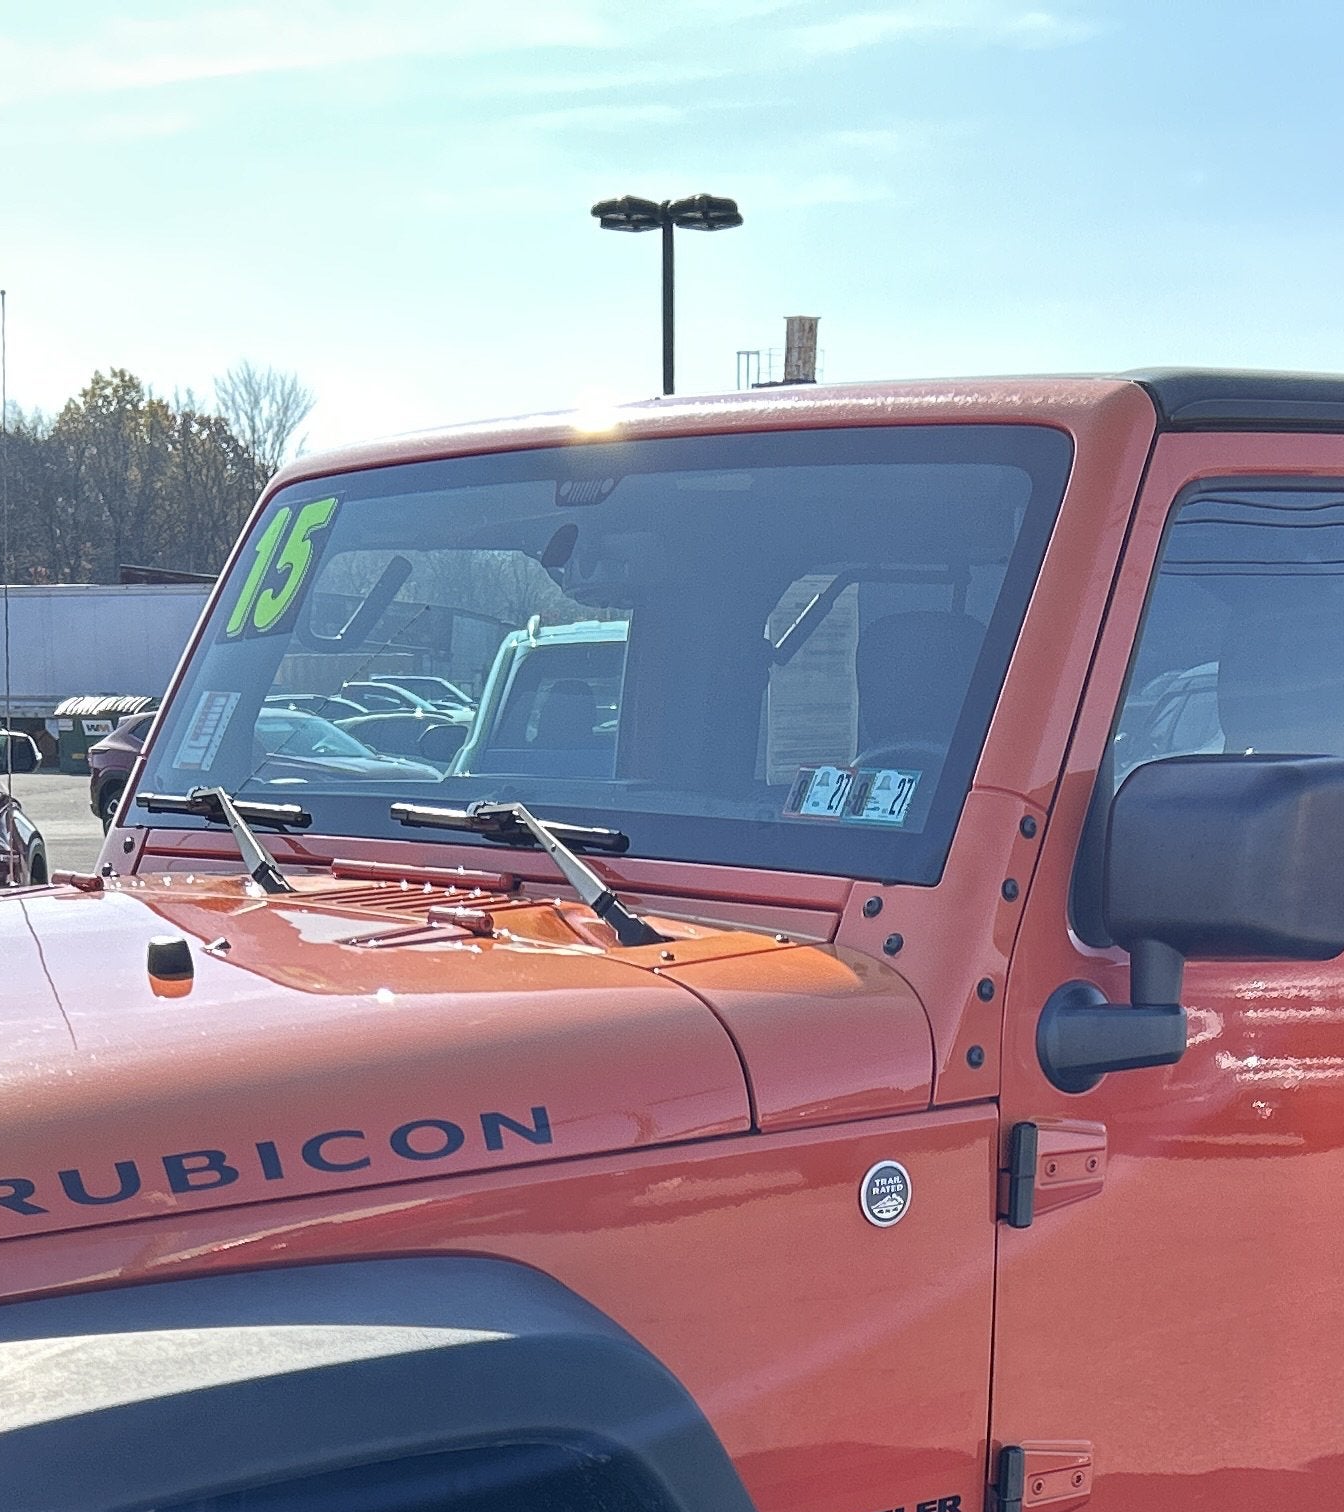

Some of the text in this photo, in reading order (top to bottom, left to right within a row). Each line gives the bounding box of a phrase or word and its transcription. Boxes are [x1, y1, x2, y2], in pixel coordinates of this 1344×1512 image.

[226, 497, 338, 638] 15
[827, 774, 852, 811] 27
[888, 778, 914, 817] 27
[873, 1184, 904, 1195] RATED
[875, 1175, 902, 1187] TRAIL
